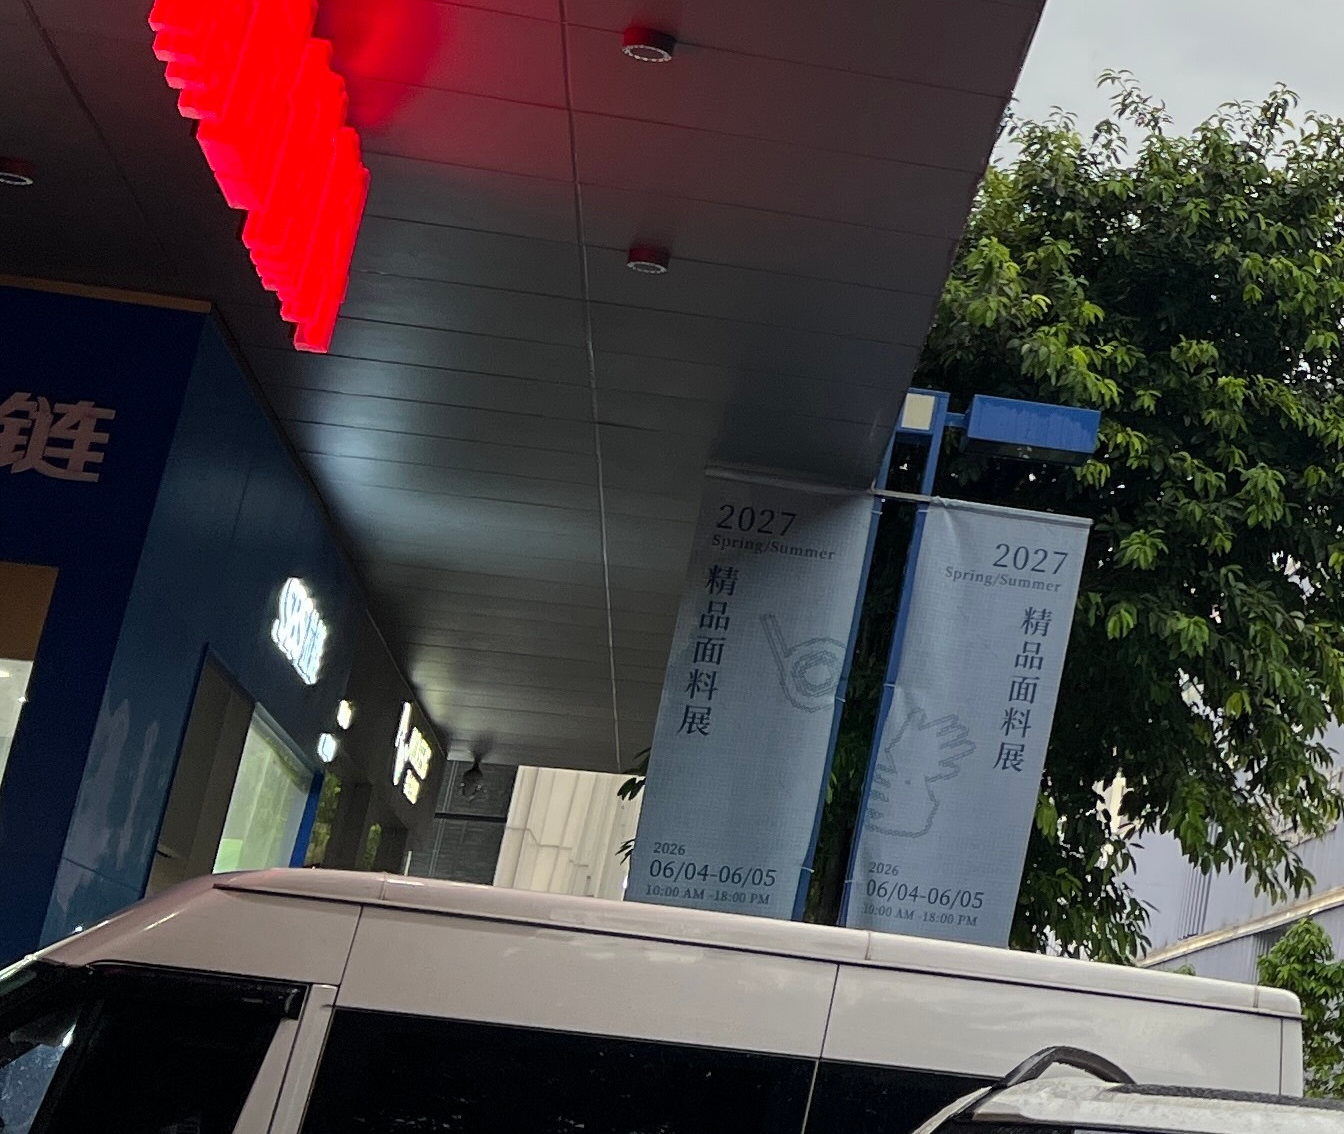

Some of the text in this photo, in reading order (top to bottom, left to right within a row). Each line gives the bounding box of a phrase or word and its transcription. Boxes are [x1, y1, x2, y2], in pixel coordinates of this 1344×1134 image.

[716, 504, 797, 536] 2027
[711, 533, 836, 561] Spring/Summer
[993, 542, 1069, 577] 2027
[944, 565, 1063, 594] Spring/Summer
[677, 564, 740, 737] 精品面料展
[993, 605, 1053, 773] 精品面料展
[653, 841, 686, 856] 2026
[649, 859, 777, 888] 06/04-06/05
[869, 861, 900, 877] 2026
[646, 884, 680, 898] 10:00
[684, 887, 705, 900] AM
[750, 893, 770, 905] PM
[866, 878, 985, 910] 06/04-06/05
[895, 908, 916, 921] AM
[957, 914, 979, 927] PM
